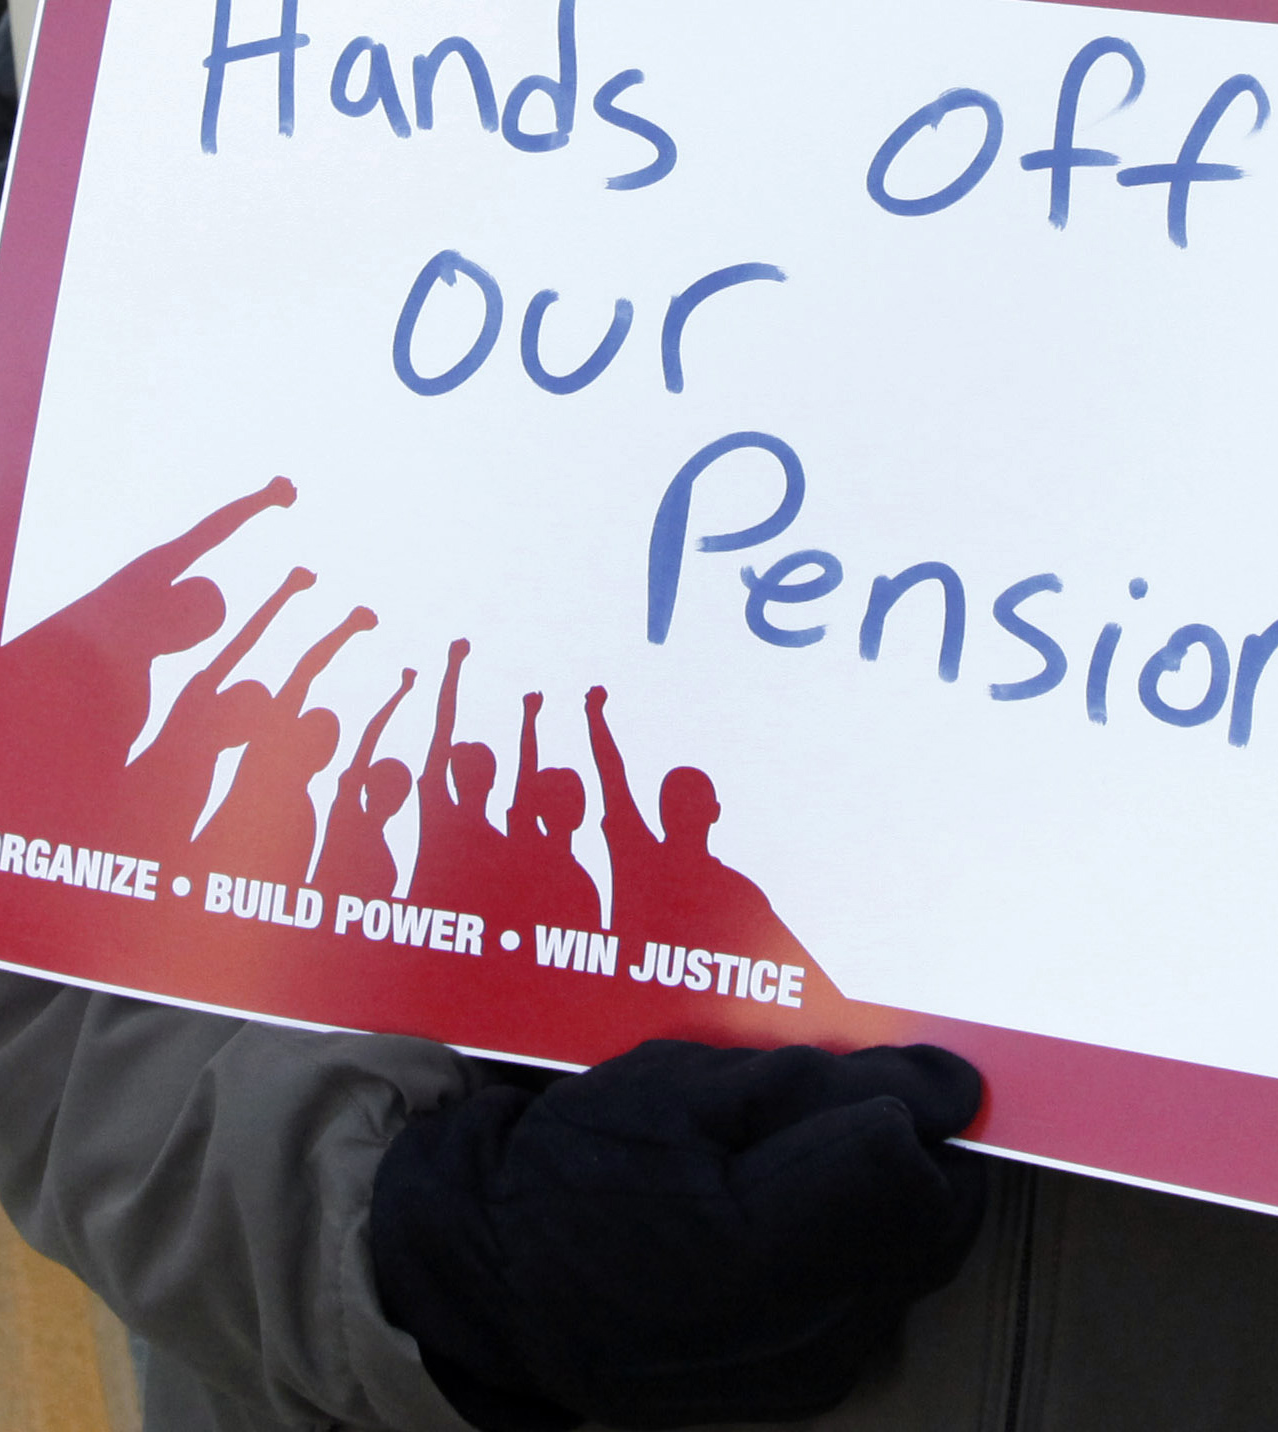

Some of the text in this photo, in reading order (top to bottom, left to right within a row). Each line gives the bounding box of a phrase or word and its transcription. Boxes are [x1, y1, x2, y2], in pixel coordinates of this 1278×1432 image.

[204, 873, 324, 932] BUILD
[335, 897, 486, 957] POWER
[534, 924, 617, 978] WIN
[629, 940, 805, 1010] JUSTICE
